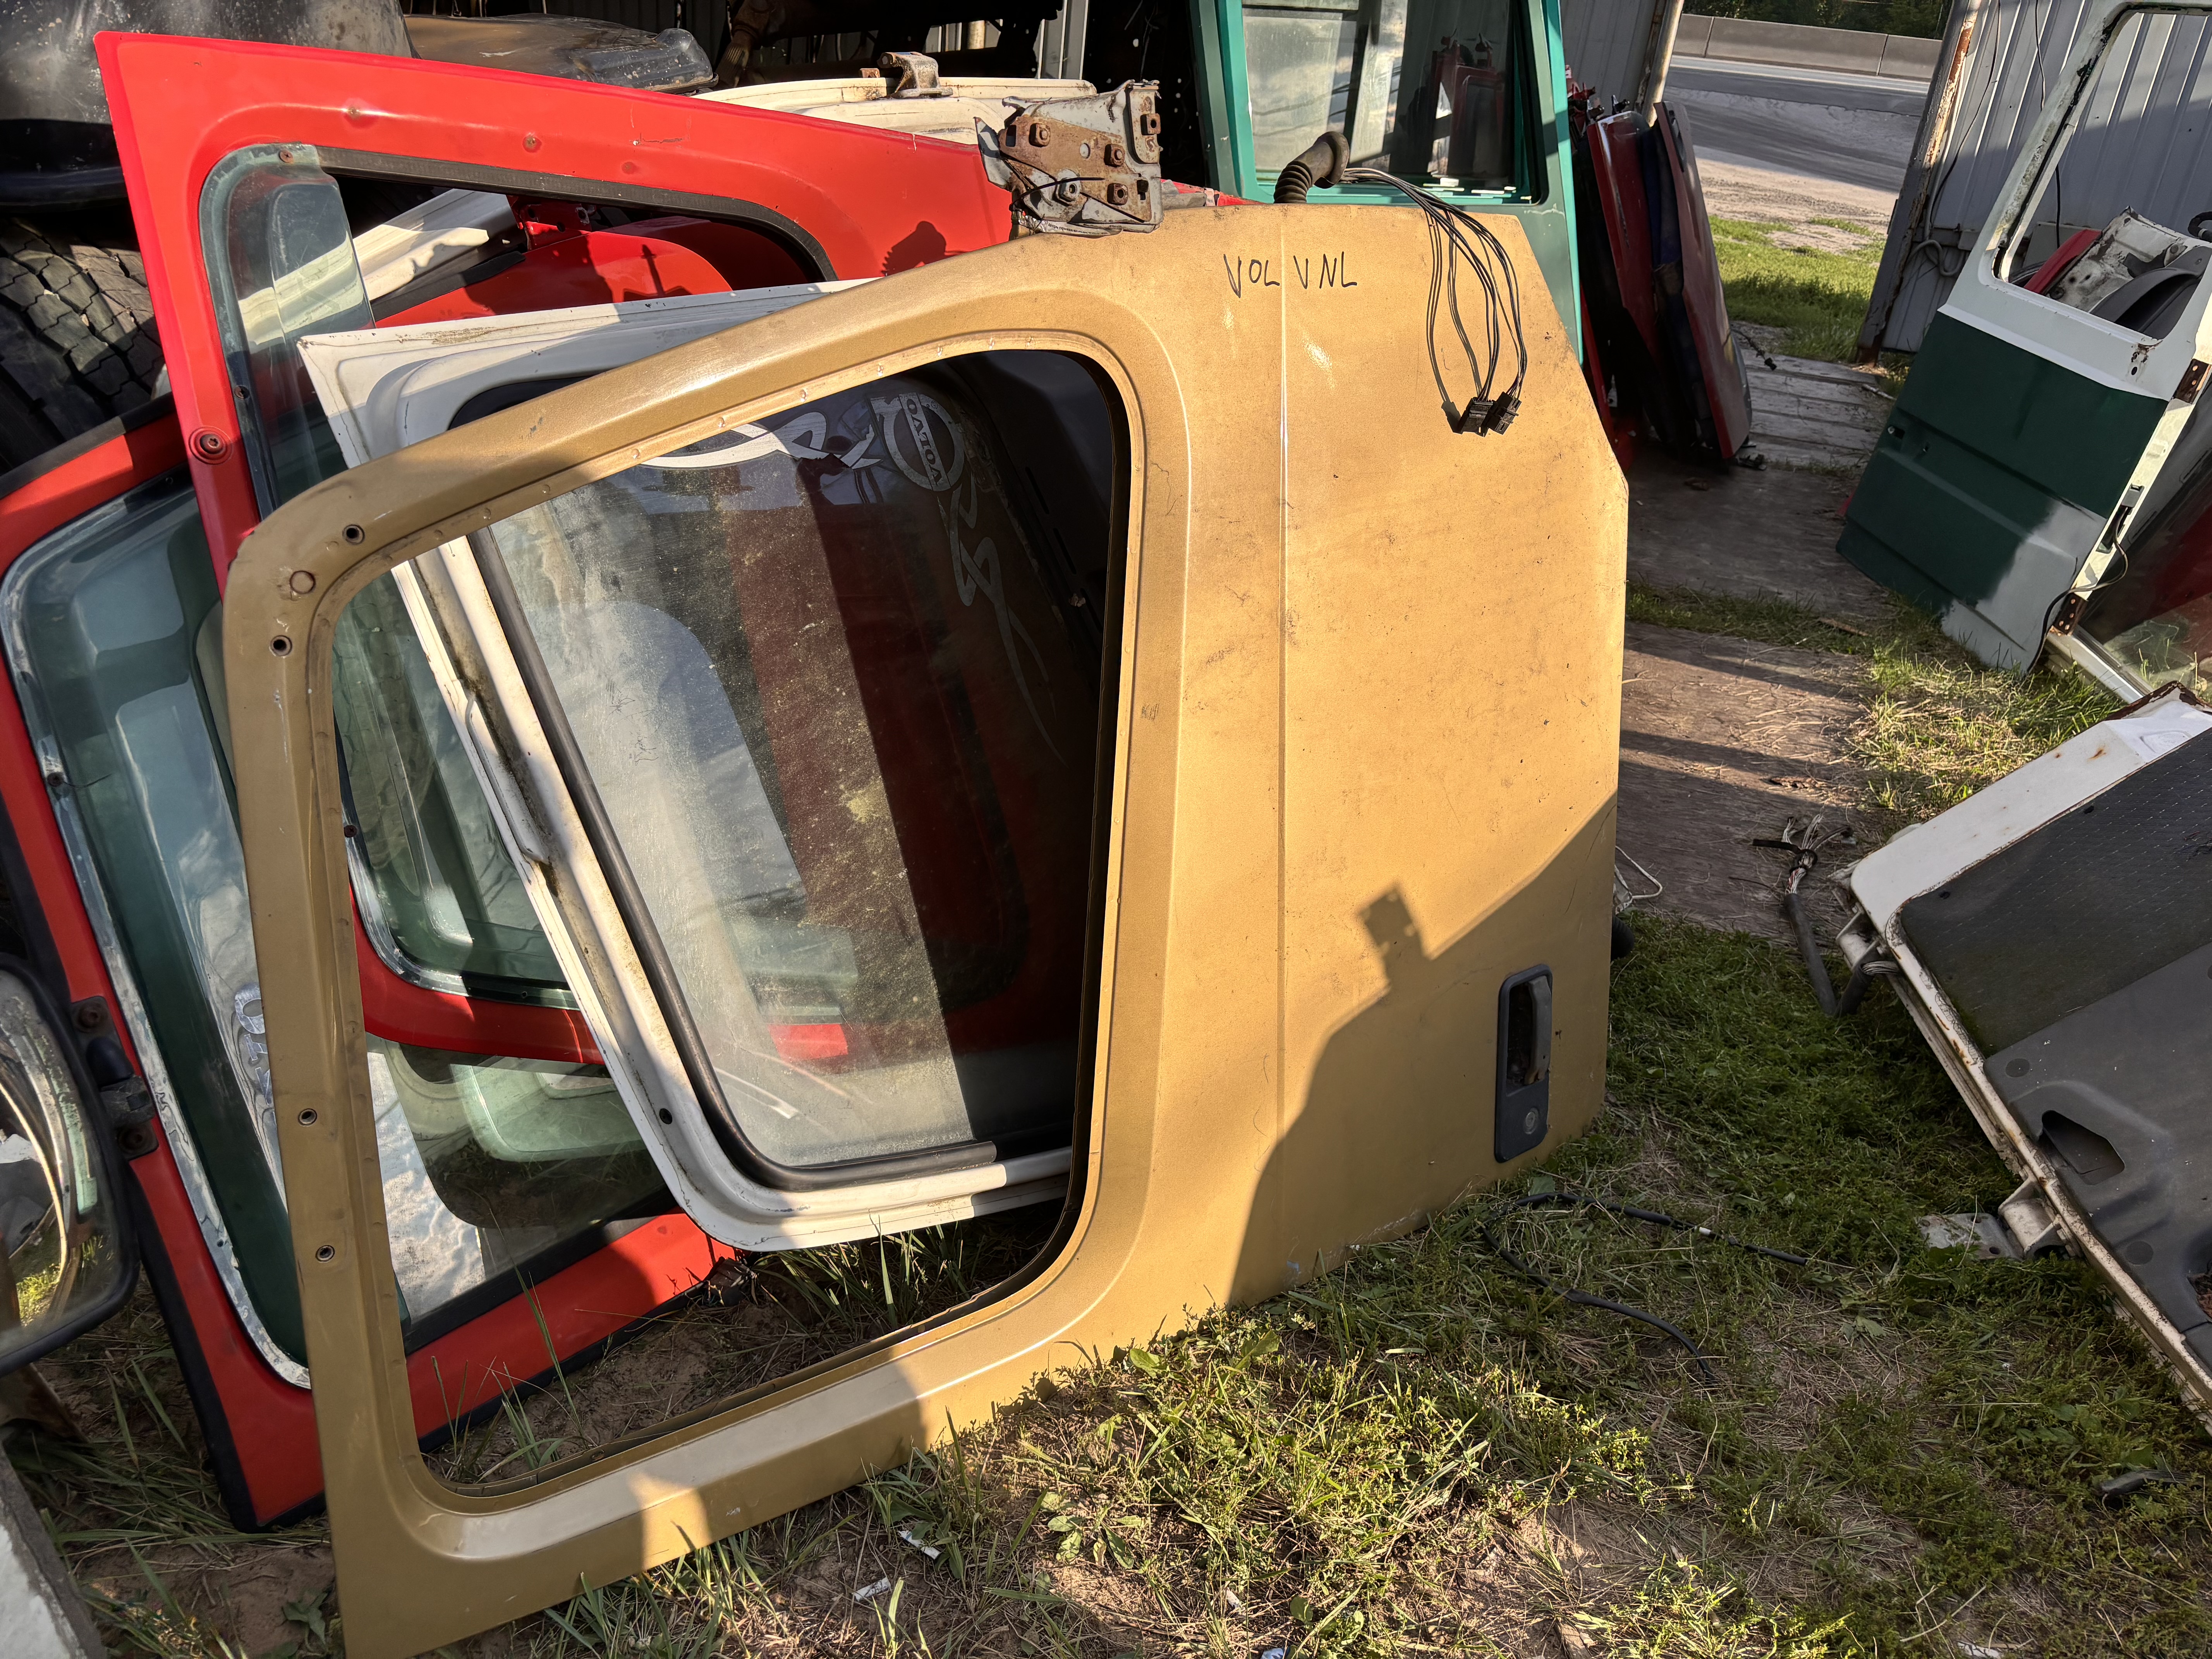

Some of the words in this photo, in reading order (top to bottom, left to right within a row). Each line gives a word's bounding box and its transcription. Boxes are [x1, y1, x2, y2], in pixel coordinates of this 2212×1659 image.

[1223, 254, 1280, 299] VOL
[1293, 251, 1357, 290] VNL
[906, 398, 942, 486] VOLVO
